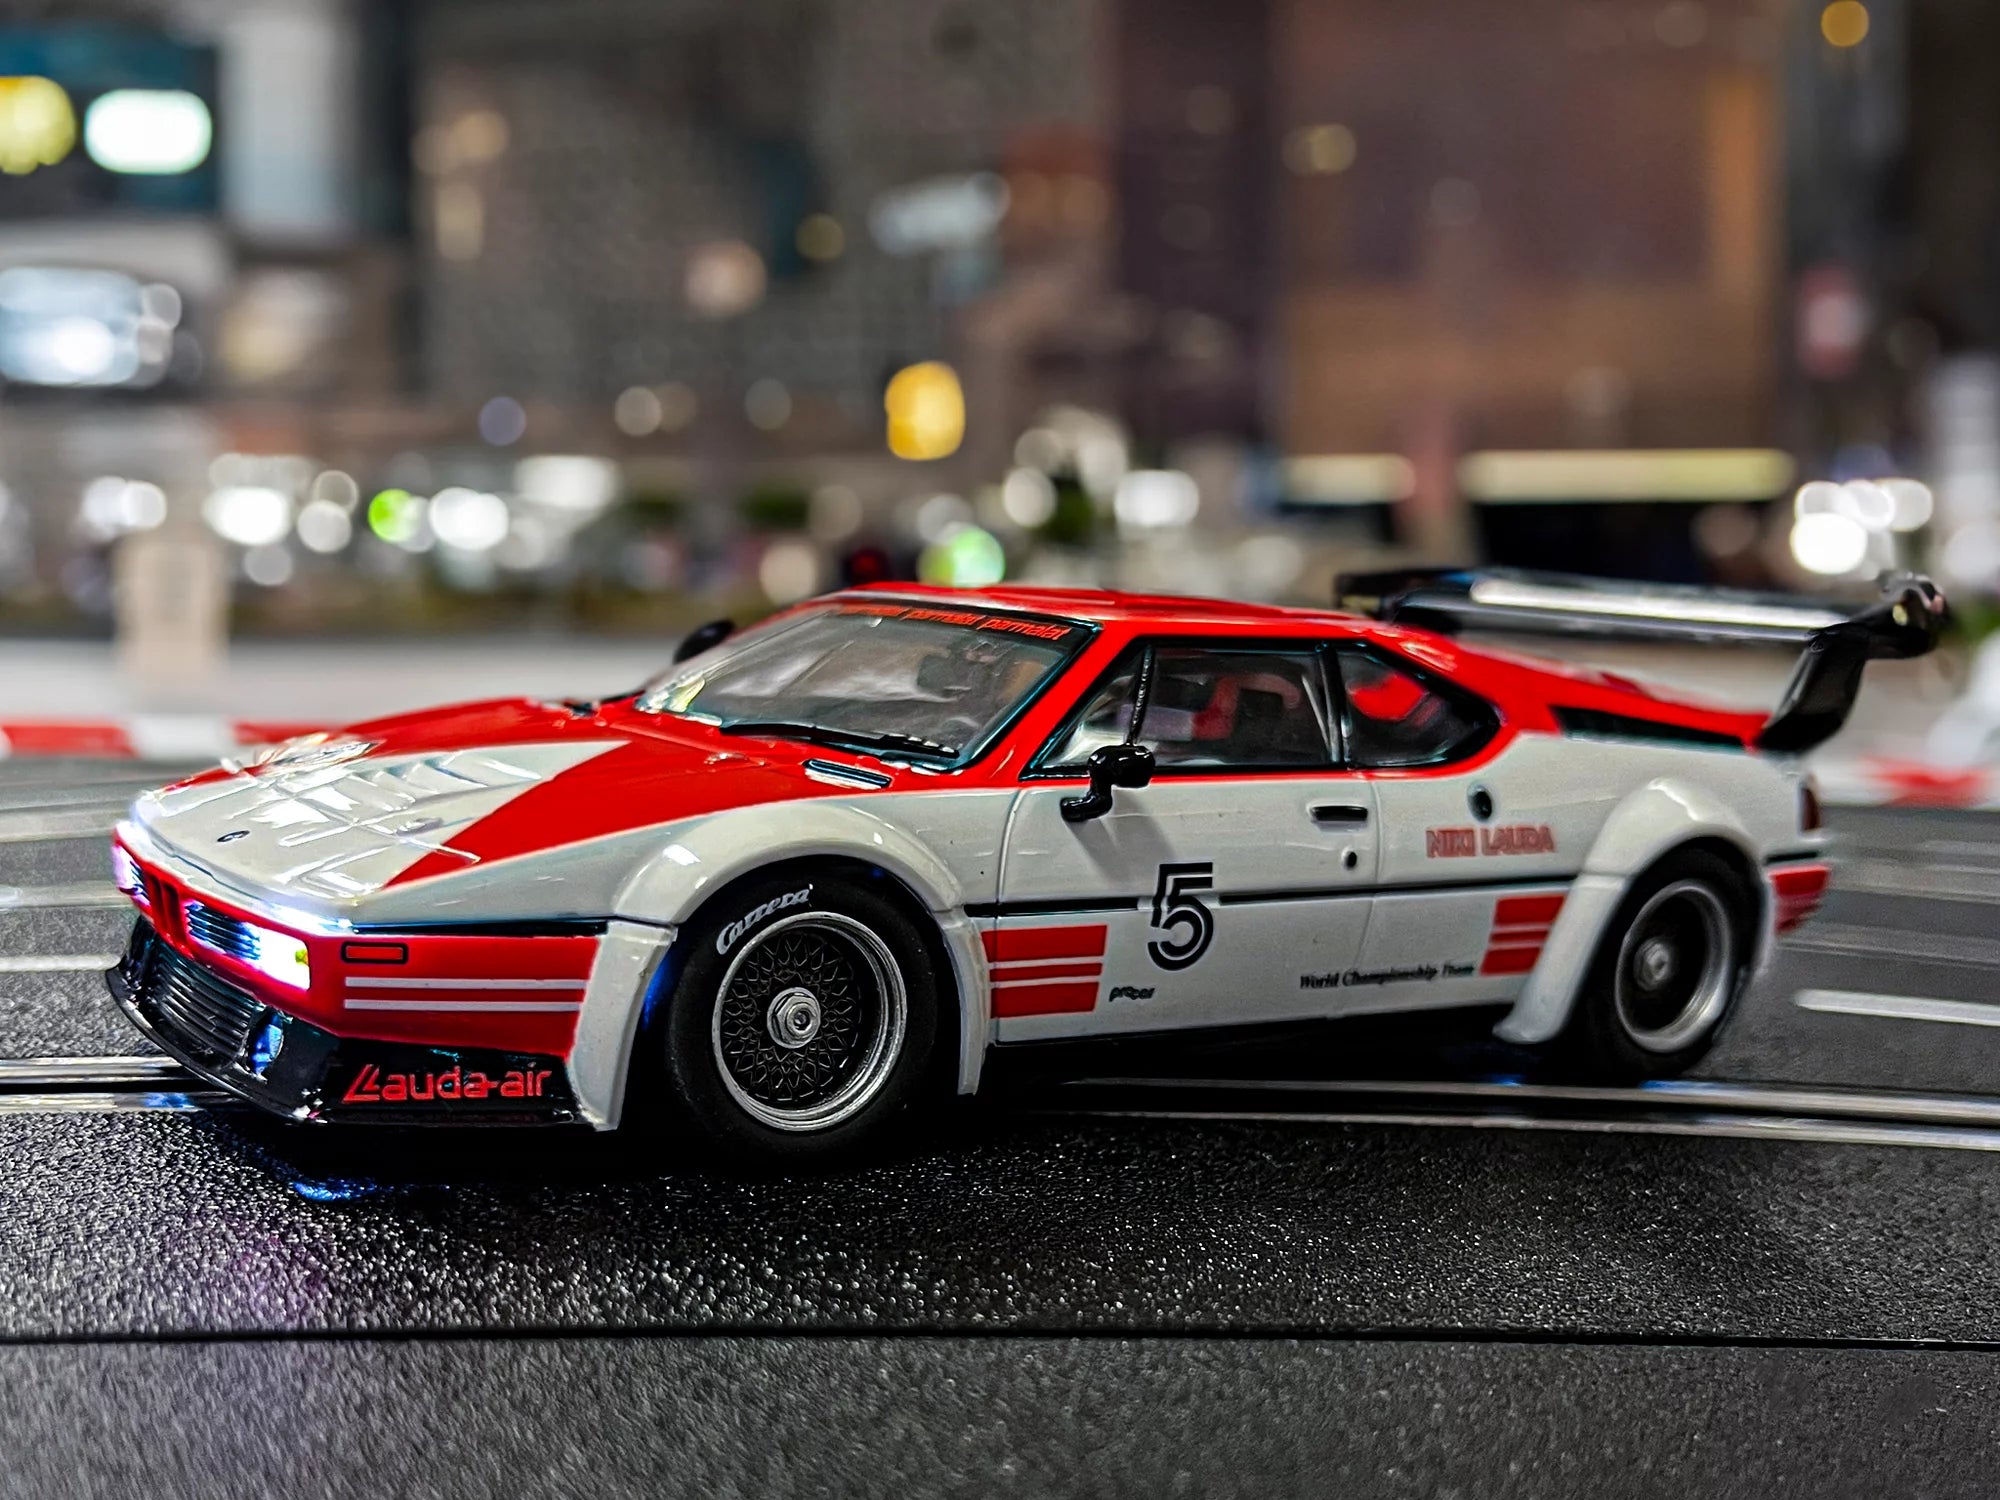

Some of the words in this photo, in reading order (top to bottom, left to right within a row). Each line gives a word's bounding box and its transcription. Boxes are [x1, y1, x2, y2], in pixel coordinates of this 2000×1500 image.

[976, 618, 1072, 640] parmalat
[1480, 826, 1556, 856] LAUDA
[716, 888, 809, 955] Carrera
[1148, 861, 1213, 971] 5
